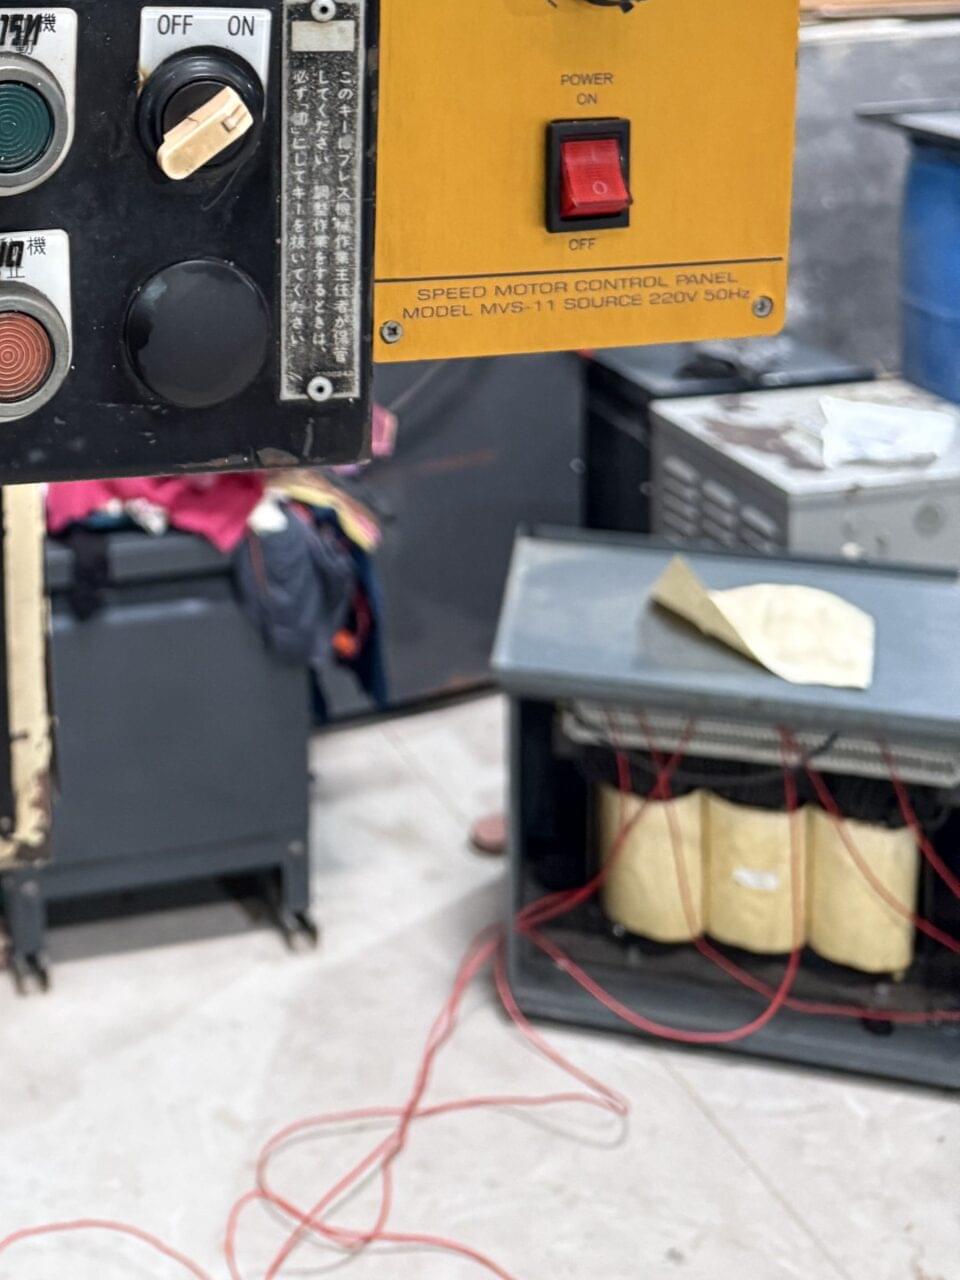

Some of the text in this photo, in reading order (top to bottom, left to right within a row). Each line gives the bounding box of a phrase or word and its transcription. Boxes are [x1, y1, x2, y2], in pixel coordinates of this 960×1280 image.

[157, 14, 193, 35] OFF
[227, 15, 255, 36] ON
[560, 73, 614, 86] POWER
[576, 93, 597, 105] ON
[569, 238, 596, 251] OFF
[416, 272, 738, 301] SPEED MOTOR CONTROL PANEL
[402, 286, 750, 320] MODEL MVS-11 SOURCE 220V 50Hz
